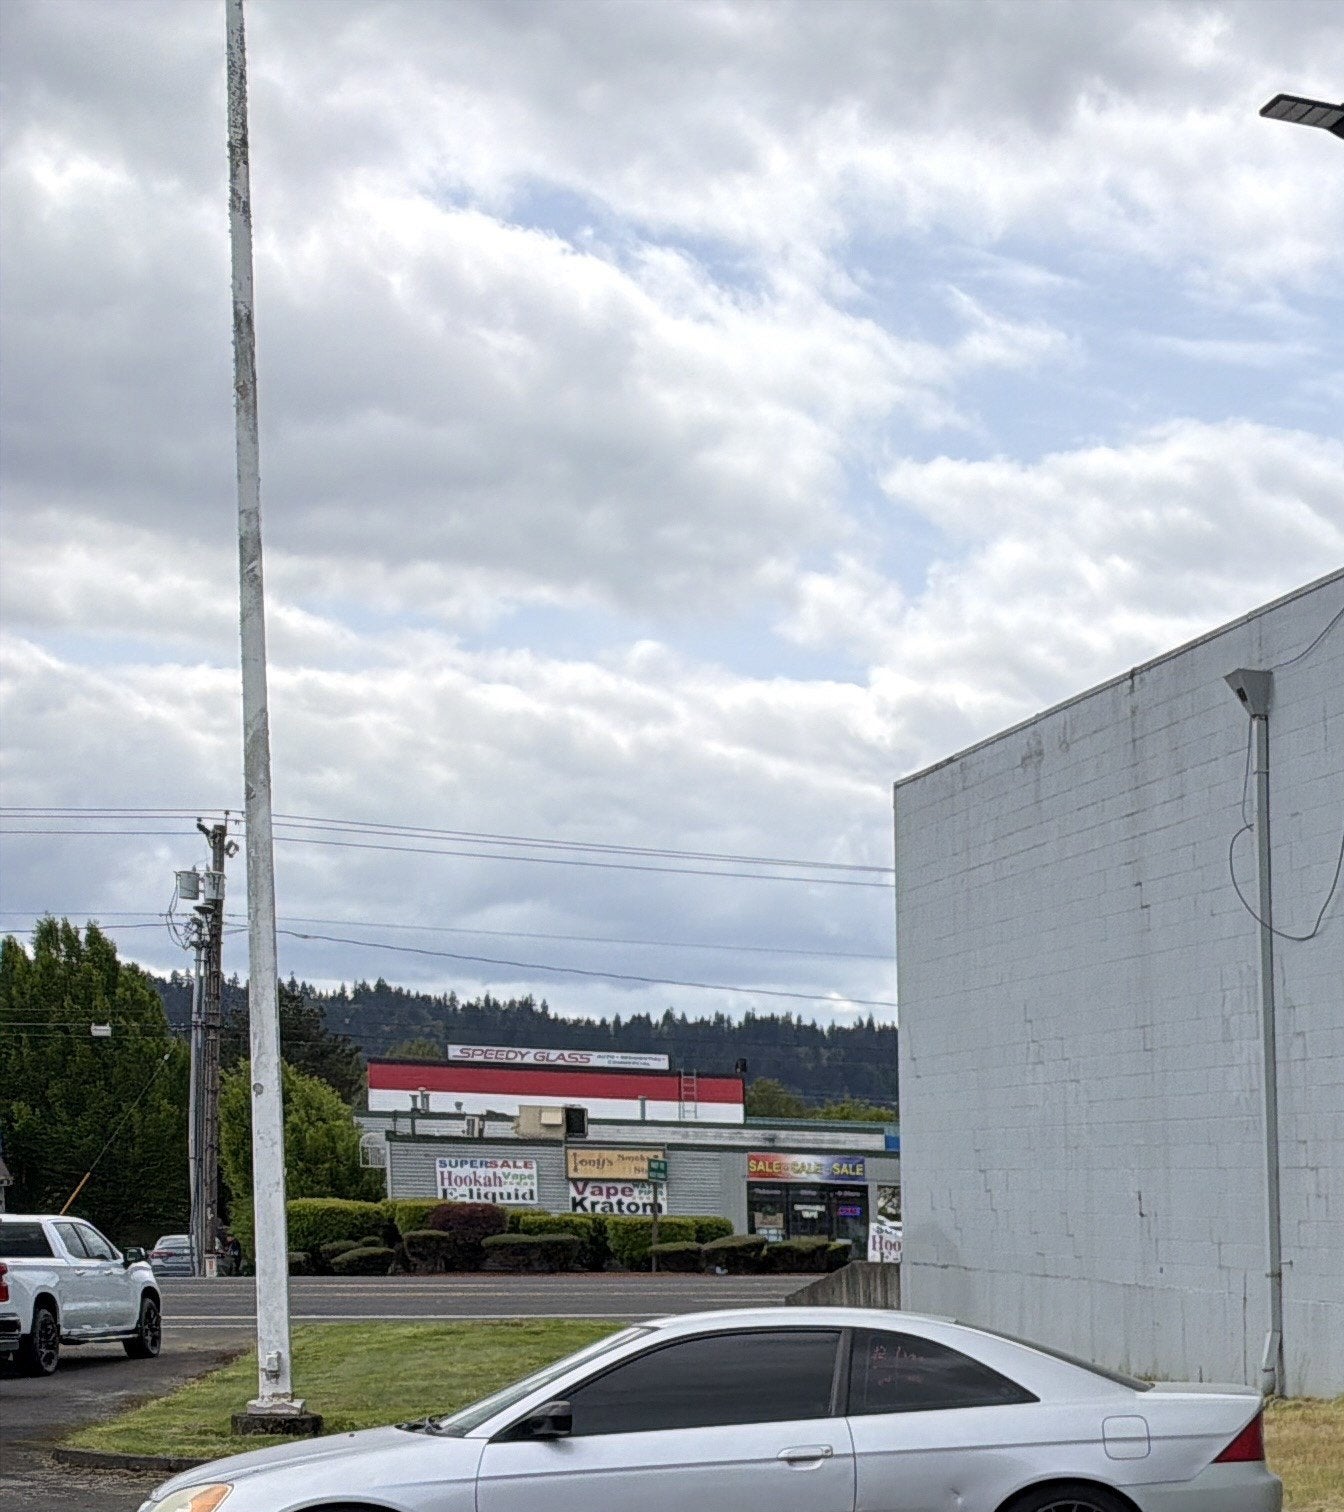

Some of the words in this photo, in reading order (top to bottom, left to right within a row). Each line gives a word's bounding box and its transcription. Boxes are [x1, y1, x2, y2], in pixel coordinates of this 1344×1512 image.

[452, 1047, 532, 1061] SPEEDY
[533, 1051, 593, 1064] GLASS
[750, 1160, 782, 1173] SALE
[832, 1163, 864, 1176] SALE
[440, 1171, 503, 1188] Hookah
[502, 1172, 535, 1183] Vape
[442, 1188, 534, 1203] E-liquid
[571, 1181, 634, 1199] Vape
[571, 1196, 663, 1214] Kratom
